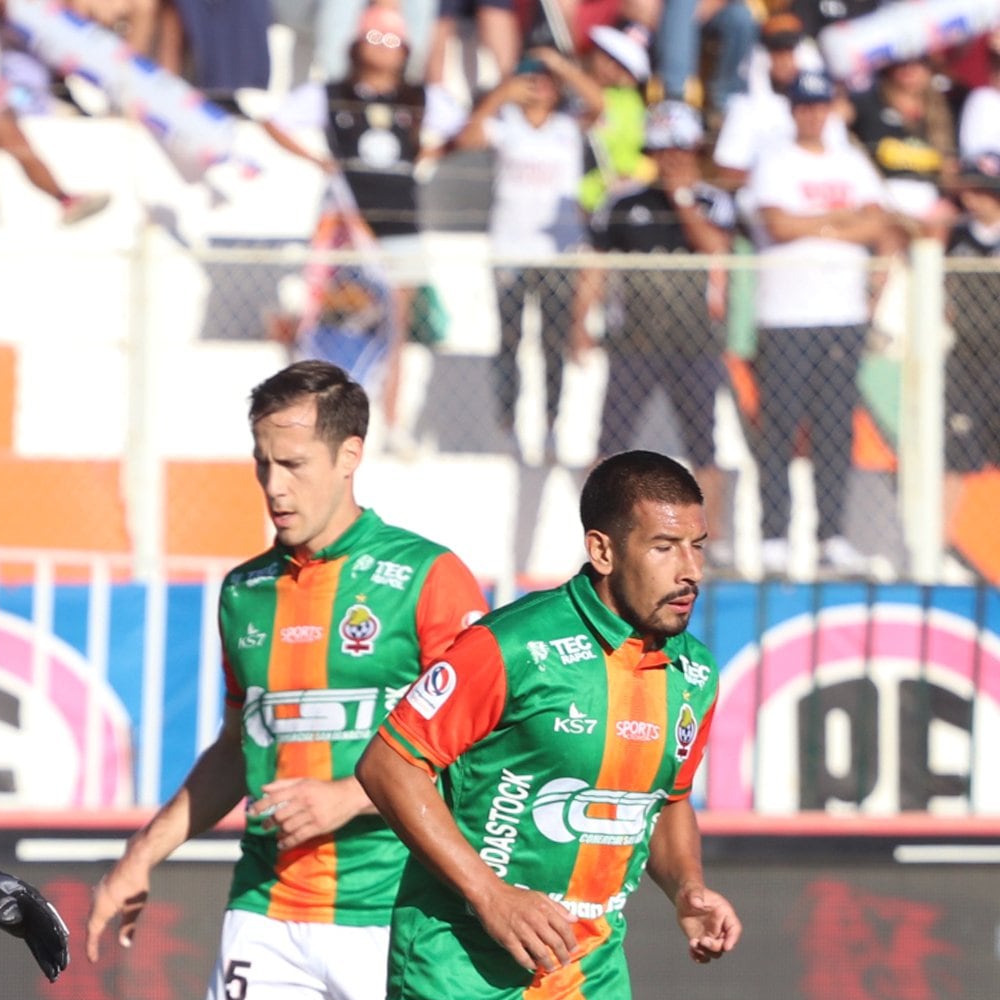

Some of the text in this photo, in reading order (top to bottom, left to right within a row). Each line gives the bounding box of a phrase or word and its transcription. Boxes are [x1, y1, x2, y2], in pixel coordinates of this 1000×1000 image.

[549, 634, 592, 652] TEC
[560, 650, 598, 666] RAPOL
[553, 717, 598, 735] KS7
[479, 768, 534, 878] ODASTOCK
